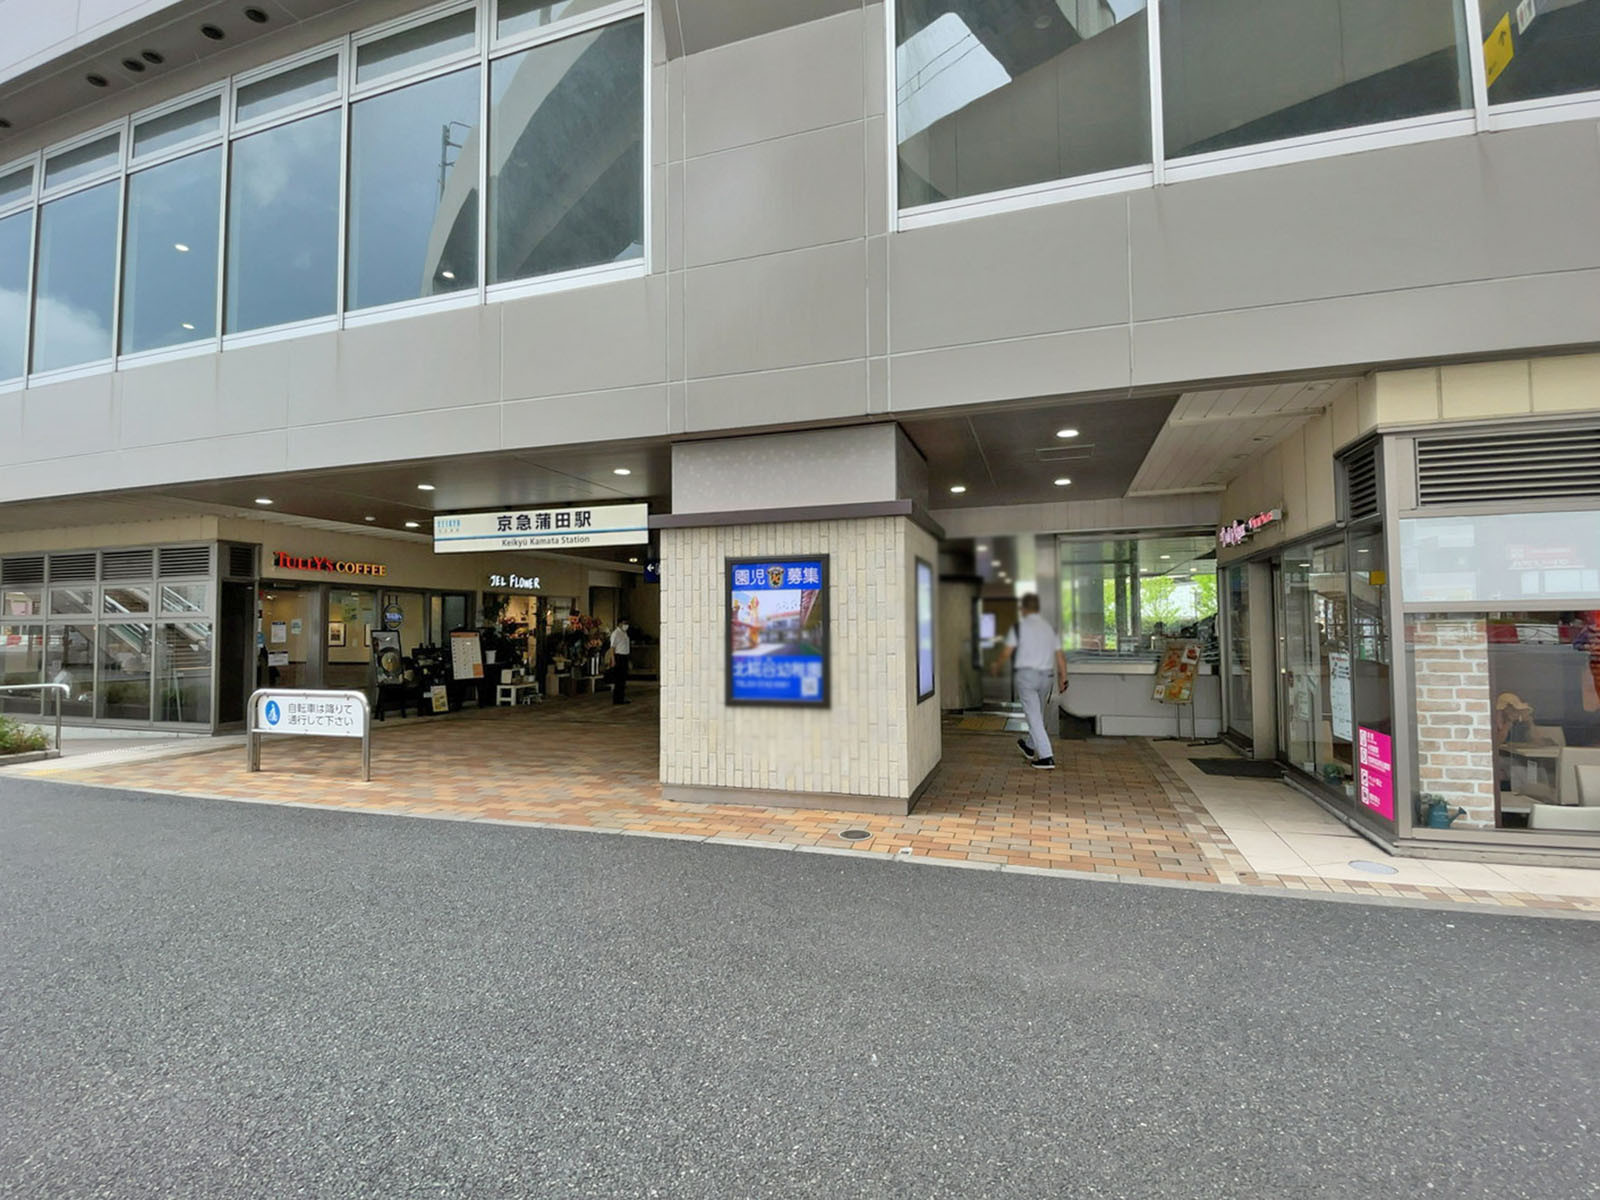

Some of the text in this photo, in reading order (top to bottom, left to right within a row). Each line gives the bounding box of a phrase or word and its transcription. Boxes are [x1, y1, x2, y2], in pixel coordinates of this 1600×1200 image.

[497, 510, 592, 532] 京急蒲田駅
[530, 536, 560, 546] Kamata
[561, 534, 590, 545] Station
[336, 560, 387, 576] COFFEE
[734, 566, 819, 585] 園児 募集
[490, 573, 541, 589] JEL FLOWER
[288, 703, 353, 715] 自転車は降りて
[288, 715, 354, 727] 通行して下さい
